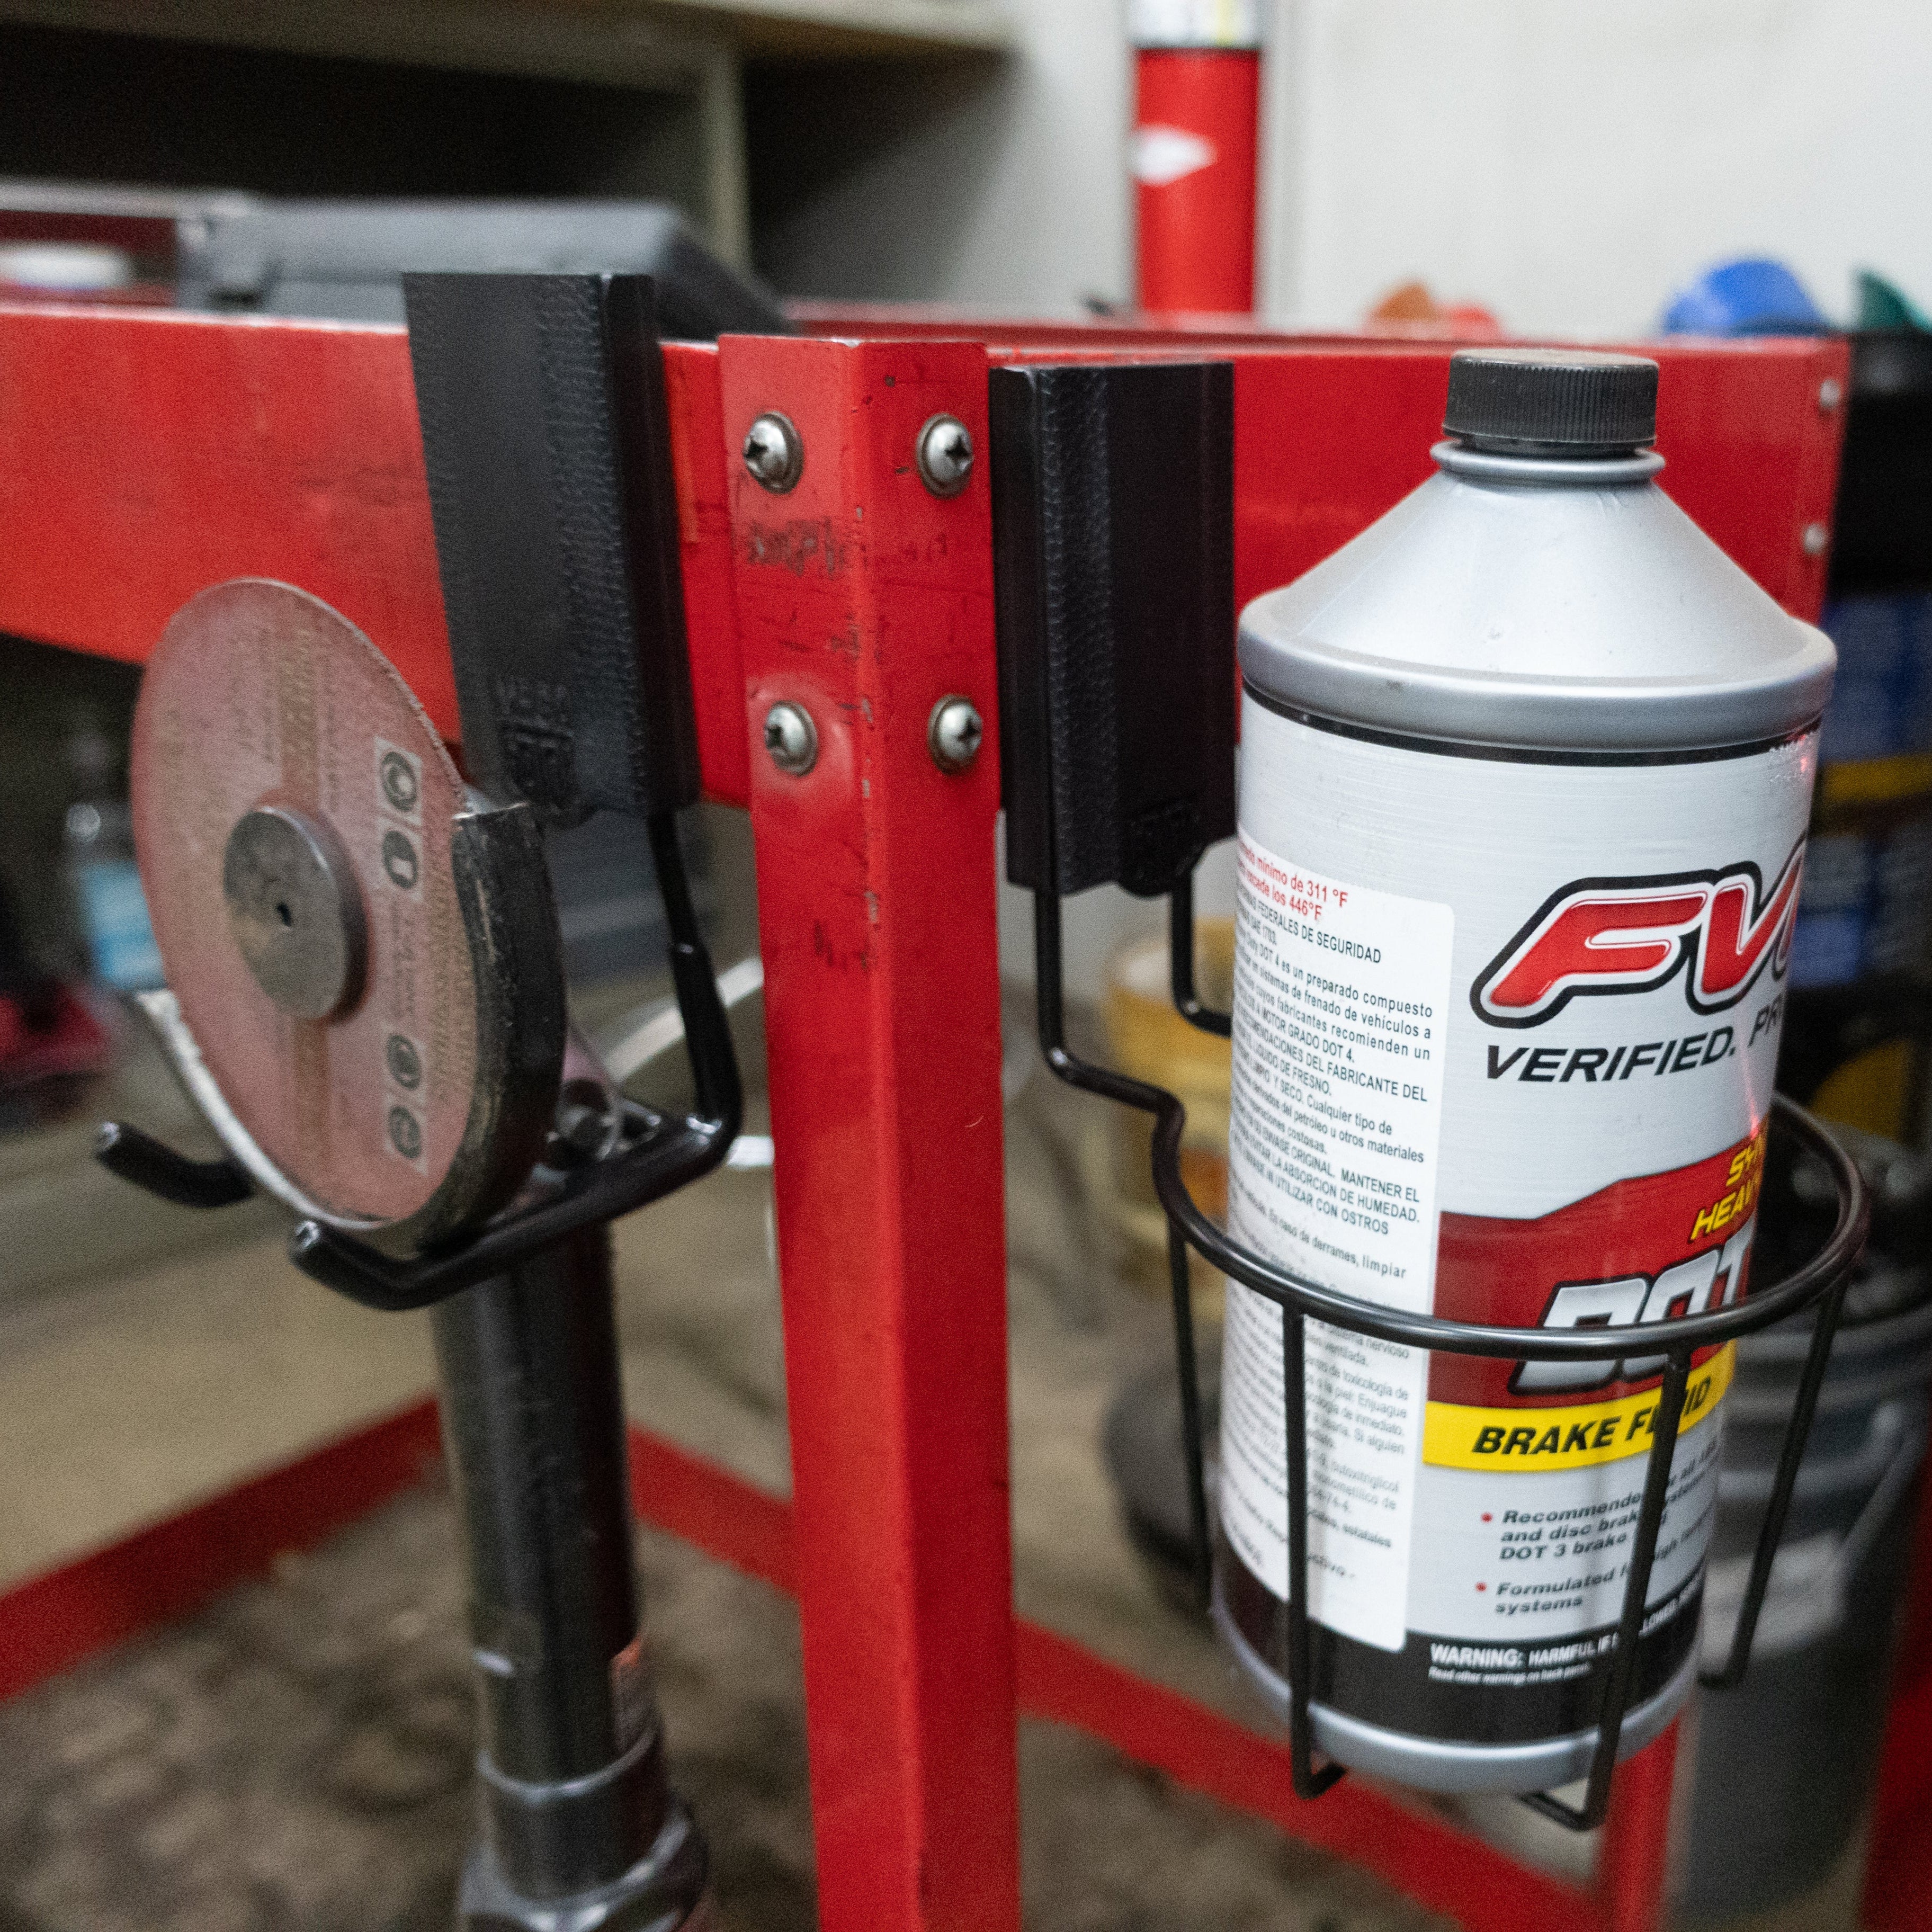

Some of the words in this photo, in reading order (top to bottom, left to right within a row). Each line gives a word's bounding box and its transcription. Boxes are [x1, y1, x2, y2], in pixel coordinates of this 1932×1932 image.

[1272, 884, 1286, 906] los
[1289, 895, 1322, 920] 446°F
[1291, 874, 1303, 892] de
[1307, 880, 1327, 902] 311
[1301, 925, 1313, 943] DE
[1317, 931, 1381, 963] SEGURIDAD
[1470, 831, 1805, 1029] FV
[1281, 960, 1290, 973] es
[1293, 967, 1303, 980] un
[1307, 973, 1359, 1000] preparado
[1363, 992, 1433, 1018] compuesto
[1277, 996, 1327, 1032] fabricantes
[1331, 1024, 1408, 1057] recomienden
[1414, 1047, 1430, 1060] un
[1291, 985, 1301, 1000] de
[1304, 989, 1341, 1016] frenado
[1345, 1006, 1357, 1021] de
[1362, 1013, 1419, 1037] vehículos
[1424, 1028, 1430, 1039] a
[1287, 1023, 1319, 1049] GRADO
[1322, 1039, 1343, 1059] DOT
[1346, 1048, 1355, 1063] 4.
[1487, 1026, 1737, 1083] VERIFIED.
[1280, 1059, 1290, 1077] DE
[1306, 1052, 1323, 1072] DEL
[1327, 1061, 1399, 1096] FABRICANTE
[1403, 1084, 1428, 1102] DEL
[1307, 1094, 1352, 1123] Cualquier
[1355, 1112, 1375, 1132] tipo
[1379, 1120, 1392, 1135] de
[1330, 1126, 1336, 1138] u
[1339, 1129, 1364, 1148] otros
[1367, 1139, 1424, 1164] materiales
[1341, 1167, 1402, 1199] MANTENER
[1405, 1187, 1420, 1203] EL
[1316, 1197, 1338, 1218] CON
[1341, 1208, 1389, 1235] OSTROS
[1340, 1187, 1354, 1205] DE
[1357, 1193, 1420, 1223] HUMEDAD.
[1362, 1254, 1407, 1279] limpiar
[1471, 1415, 1621, 1455] BRAKE
[1625, 1375, 1711, 1441] FLID
[1501, 1527, 1542, 1542] and
[1549, 1524, 1591, 1540] disc
[1597, 1510, 1637, 1532] brak
[1502, 1491, 1641, 1524] Recommende
[1499, 1544, 1548, 1559] DOT
[1553, 1543, 1567, 1557] 3
[1572, 1532, 1627, 1555] brake
[1496, 1568, 1615, 1596] Formulated
[1496, 1595, 1583, 1616] systems
[1430, 1642, 1525, 1668] WARNING:
[1528, 1641, 1595, 1666] HARMFUL
